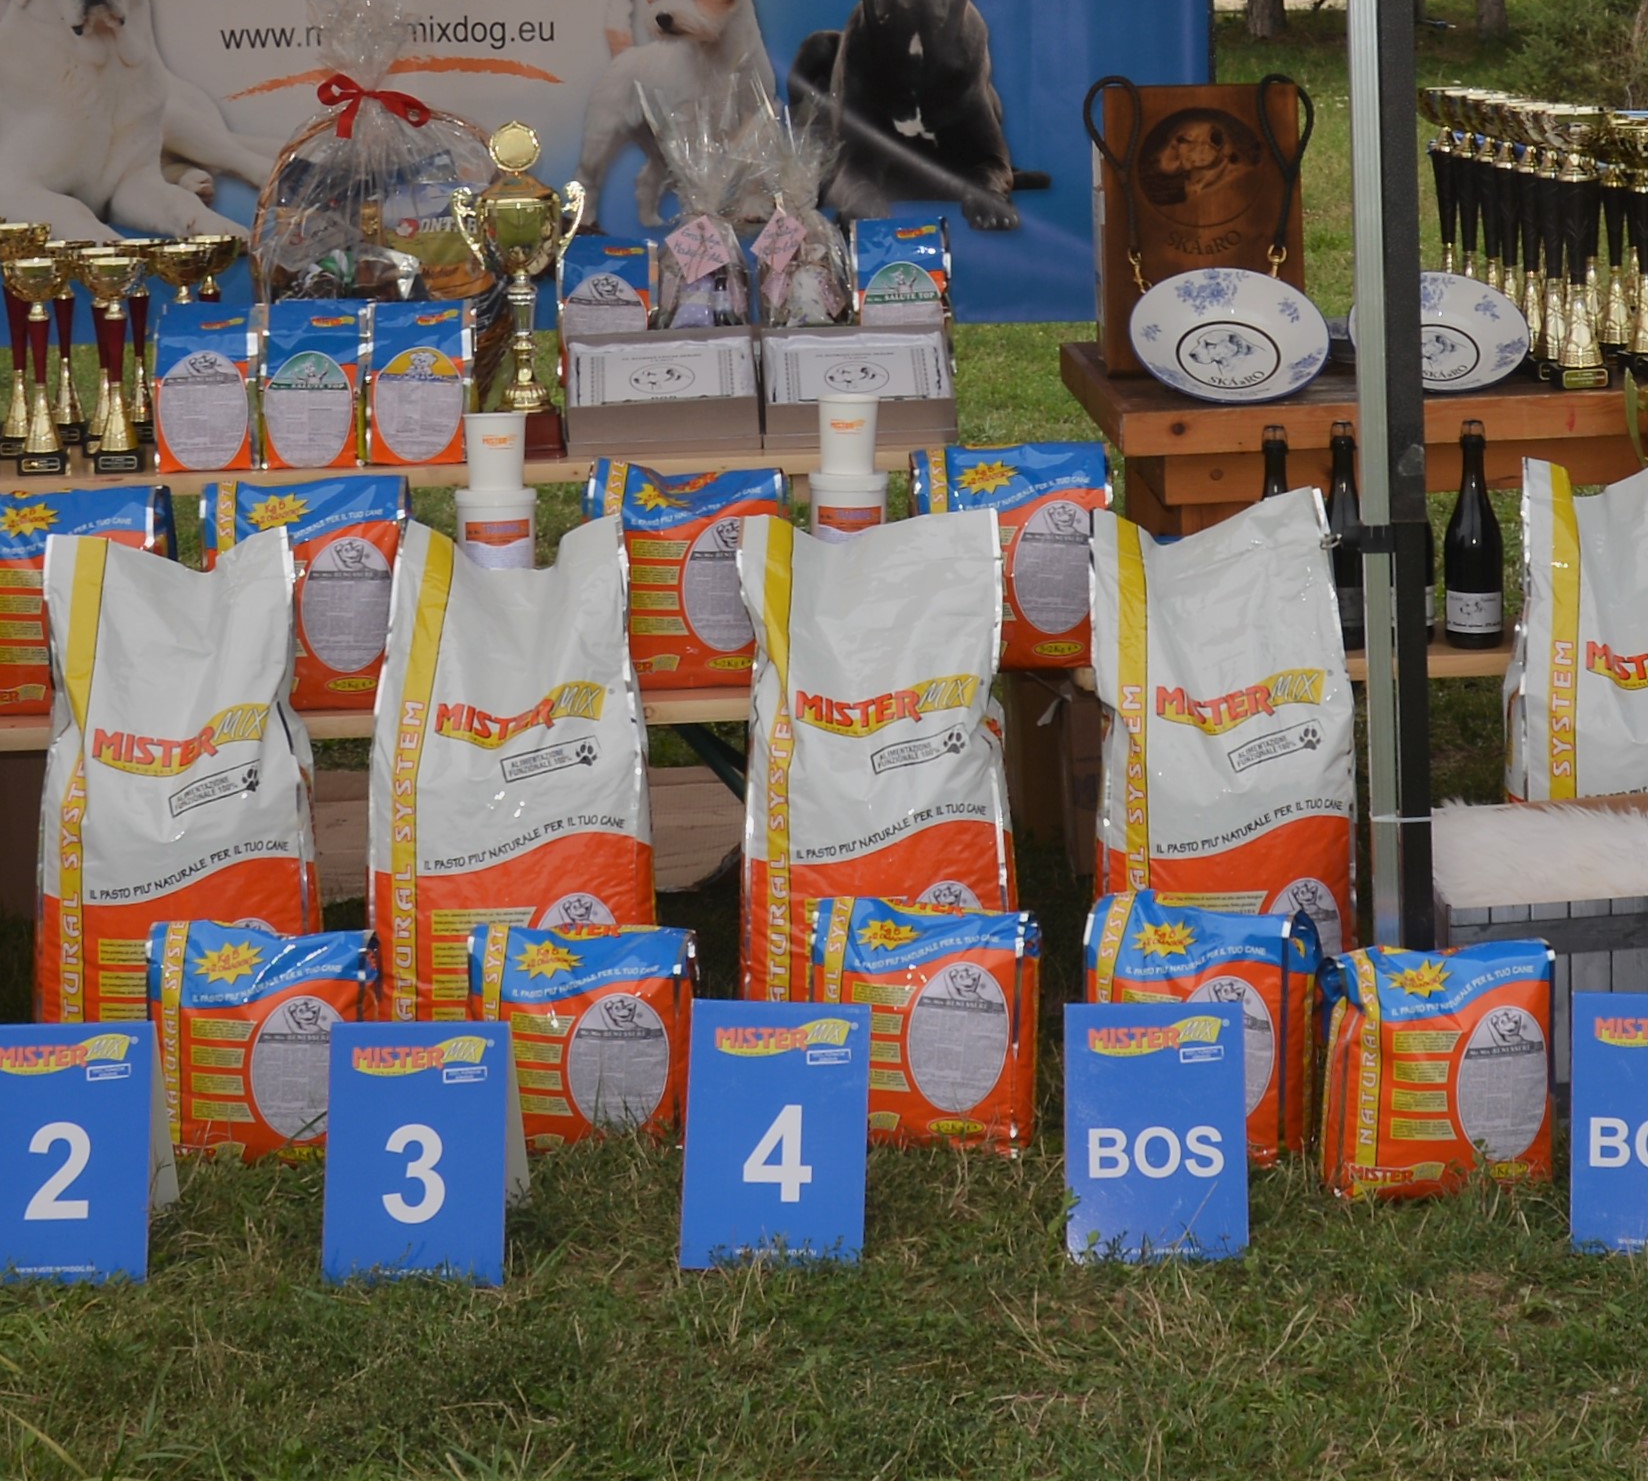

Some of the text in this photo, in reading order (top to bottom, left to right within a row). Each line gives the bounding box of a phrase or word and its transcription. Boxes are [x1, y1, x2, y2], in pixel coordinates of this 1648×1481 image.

[435, 685, 600, 740] MISTER MIX
[795, 677, 973, 728] MISTER MIX
[1272, 673, 1319, 701] MIX
[1552, 639, 1575, 777] SYSTEM
[92, 709, 269, 768] MISTER MIX
[1122, 685, 1145, 825] SYSTEM
[394, 700, 425, 844] SYSTEM
[434, 857, 466, 870] PASTO
[489, 828, 541, 859] NATURALE
[543, 820, 564, 835] PER
[577, 814, 599, 826] TUO
[599, 815, 626, 830] CANE
[87, 1038, 123, 1059] MIX
[353, 1038, 481, 1070] MISTER MIX
[714, 1022, 845, 1051] MISTER MIX
[1087, 1018, 1216, 1051] MISTER MIX
[24, 1121, 91, 1220] 2
[382, 1123, 446, 1224] 3
[743, 1104, 813, 1203] 4
[1088, 1125, 1225, 1179] BOS
